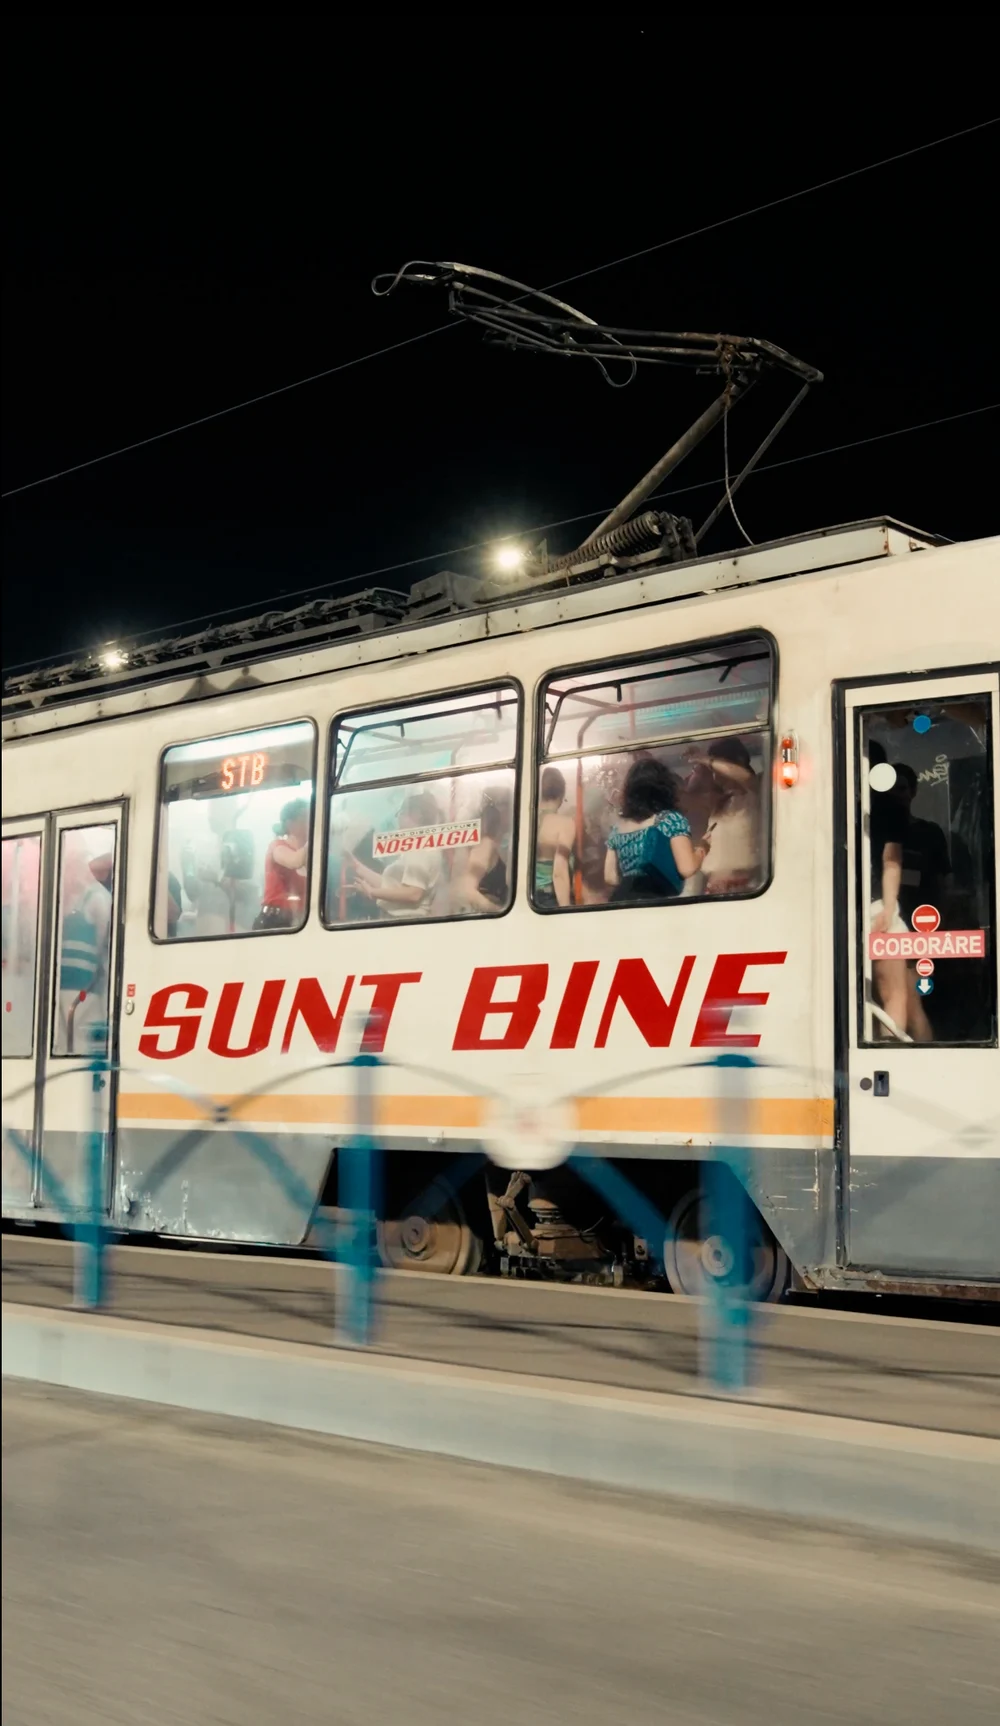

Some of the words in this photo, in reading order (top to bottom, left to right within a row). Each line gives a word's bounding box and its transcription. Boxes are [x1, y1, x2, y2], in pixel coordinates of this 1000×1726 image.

[221, 752, 265, 790] STB
[374, 828, 479, 854] NOSTALGIA
[872, 932, 981, 956] COBORÂRE
[138, 972, 423, 1060] SUNT
[452, 951, 788, 1051] BINE
